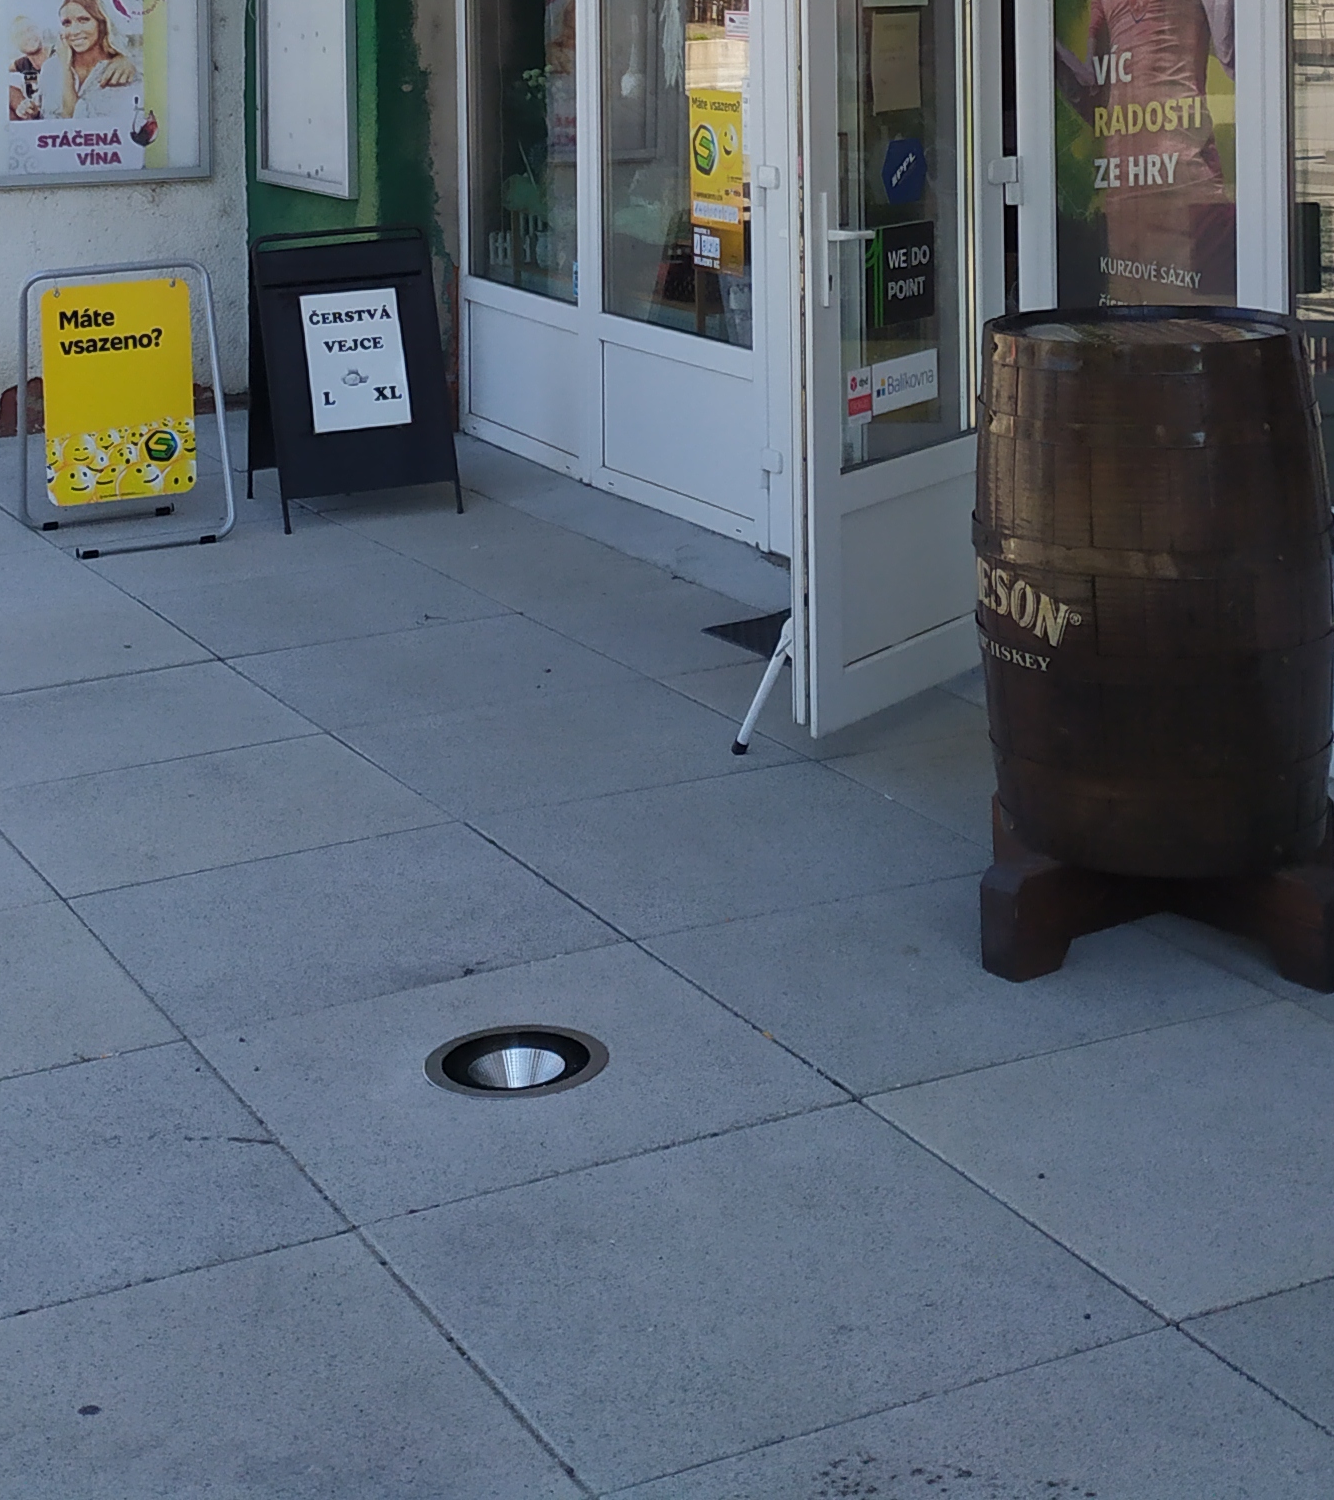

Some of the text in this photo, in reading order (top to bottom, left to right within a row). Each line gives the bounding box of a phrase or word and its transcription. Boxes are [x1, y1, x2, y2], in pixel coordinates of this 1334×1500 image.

[1092, 45, 1133, 86] VÍC
[1094, 97, 1202, 138] RADOSTI
[36, 129, 122, 149] STÁČENÁ
[76, 149, 122, 166] VÍNA
[1094, 152, 1179, 189] ZE HRY
[1100, 256, 1202, 289] KURZOVÉ SÁZKY
[887, 276, 926, 301] POINT
[59, 308, 115, 331] Máte
[308, 305, 392, 326] ČERSTVÁ
[60, 328, 163, 356] vsazeno?
[323, 336, 385, 354] VEJCE
[323, 385, 403, 406] L XL
[977, 556, 1070, 649] ESON
